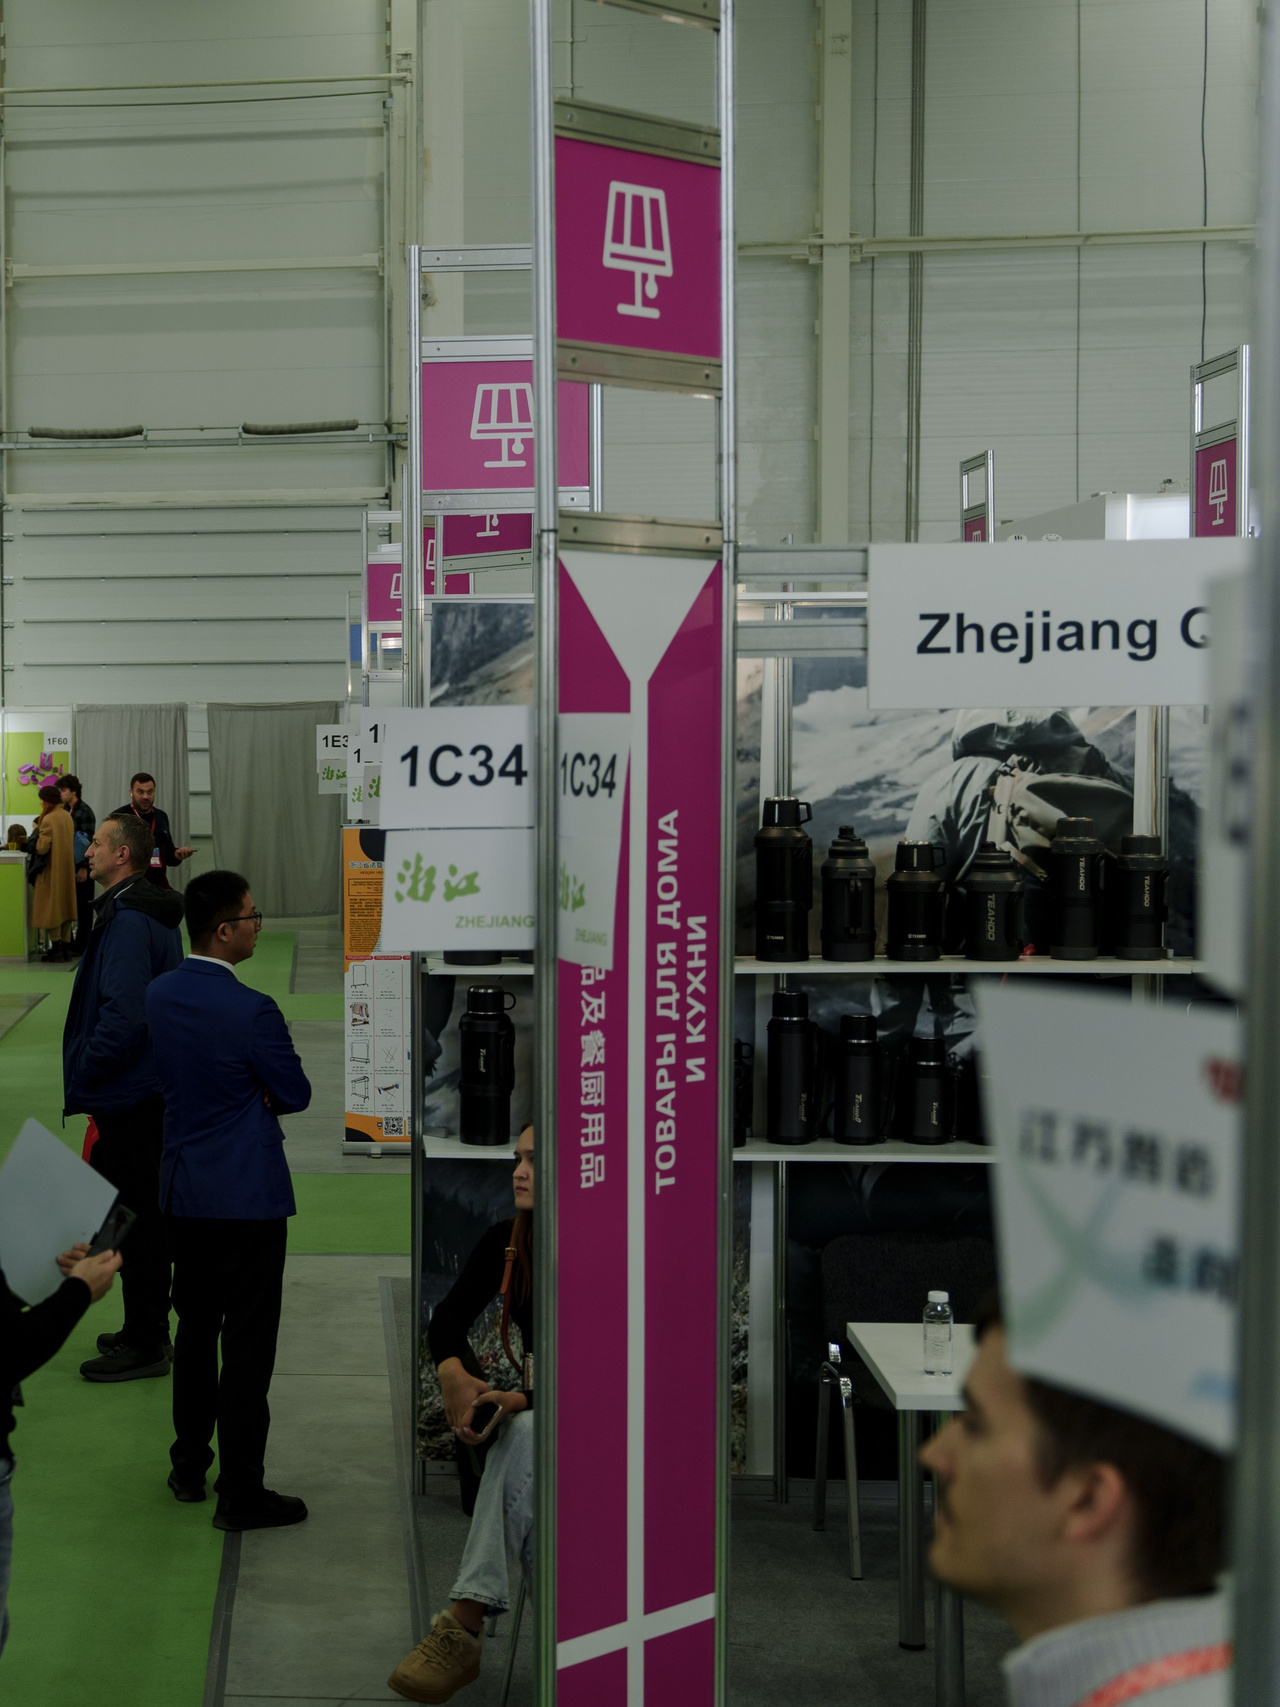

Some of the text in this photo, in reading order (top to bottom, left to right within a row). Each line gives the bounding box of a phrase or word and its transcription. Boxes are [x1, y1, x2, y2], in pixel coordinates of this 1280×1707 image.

[916, 609, 1158, 665] Zhejiang
[47, 737, 68, 746] 1F60
[322, 735, 349, 748] 1E3
[400, 744, 528, 788] 1C34
[560, 752, 618, 798] 1C34
[394, 852, 480, 904] 浙江
[454, 915, 536, 929] ZHEJIANG
[987, 893, 996, 941] TEAHOO
[655, 809, 681, 1195] ТОВАРЫ ДЛЯ ДОМА
[685, 915, 708, 1084] И КУХНИ
